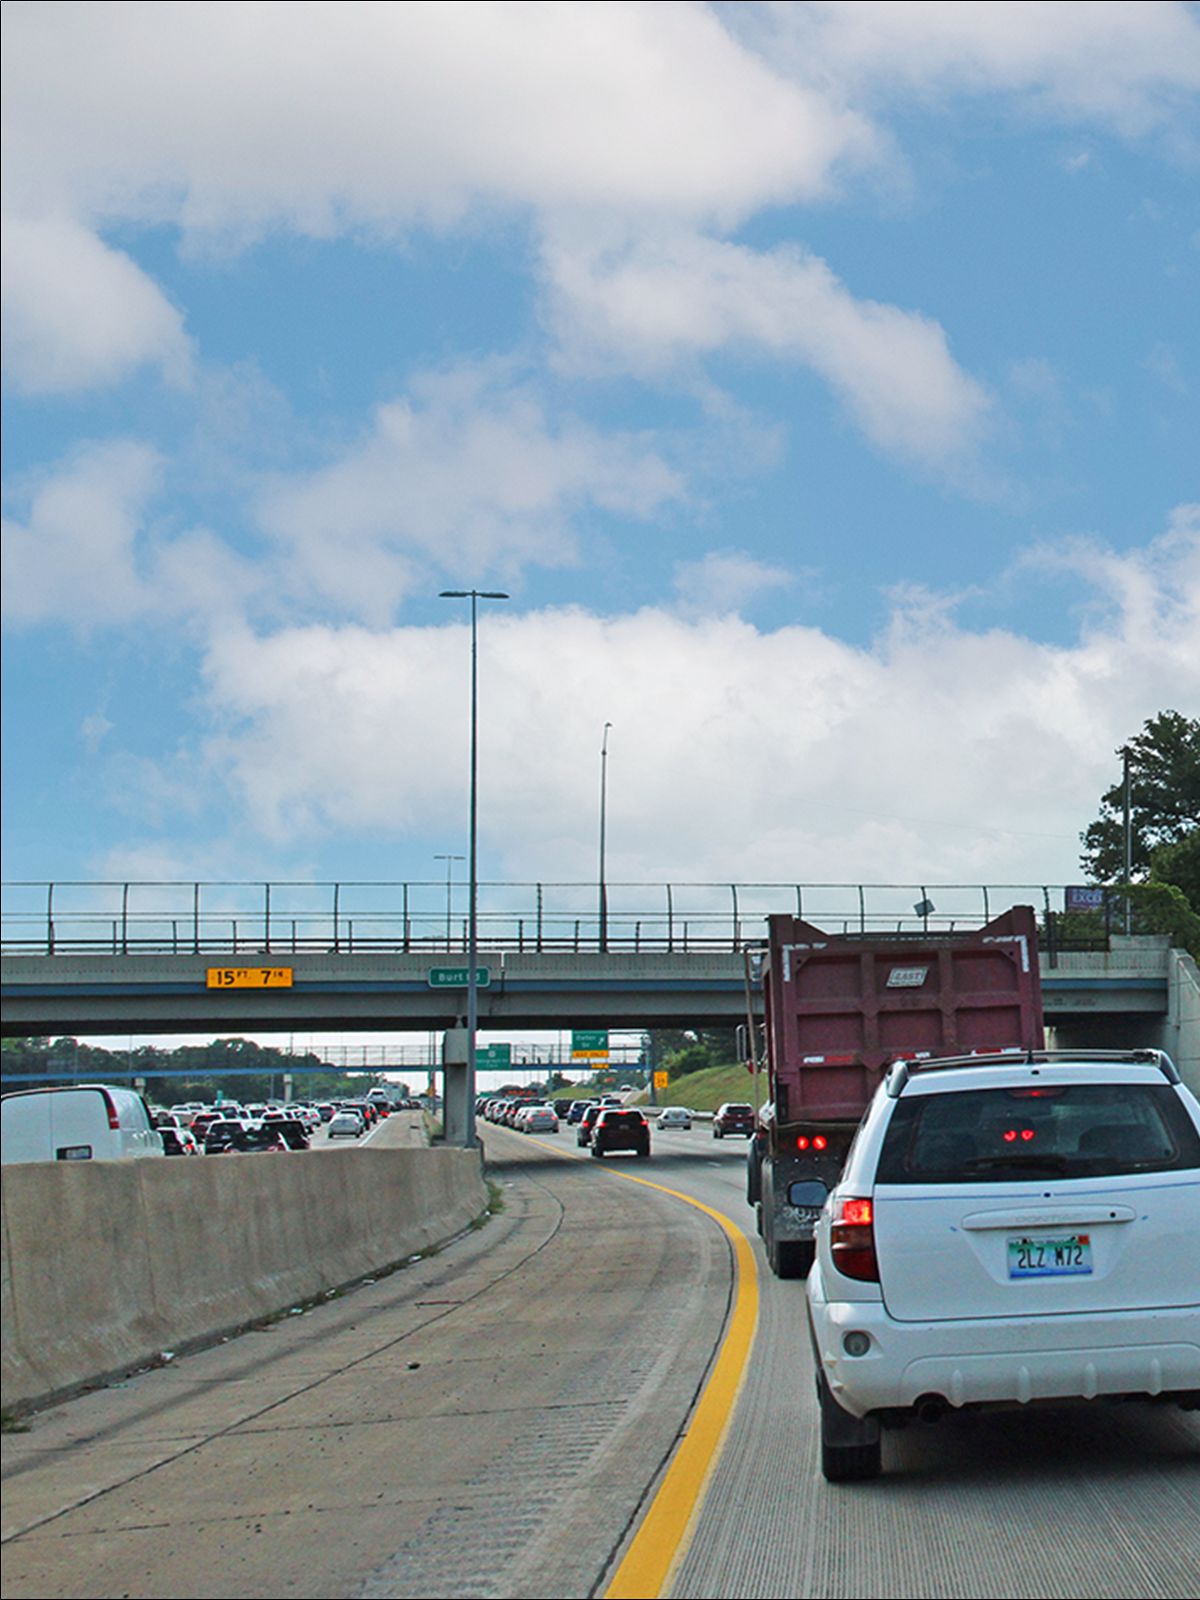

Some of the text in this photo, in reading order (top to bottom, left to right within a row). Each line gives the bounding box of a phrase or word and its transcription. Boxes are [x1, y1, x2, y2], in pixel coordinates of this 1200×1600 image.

[217, 970, 235, 985] 15
[261, 970, 271, 984] 7
[438, 972, 463, 981] Burt
[1017, 1246, 1046, 1269] 2LZ
